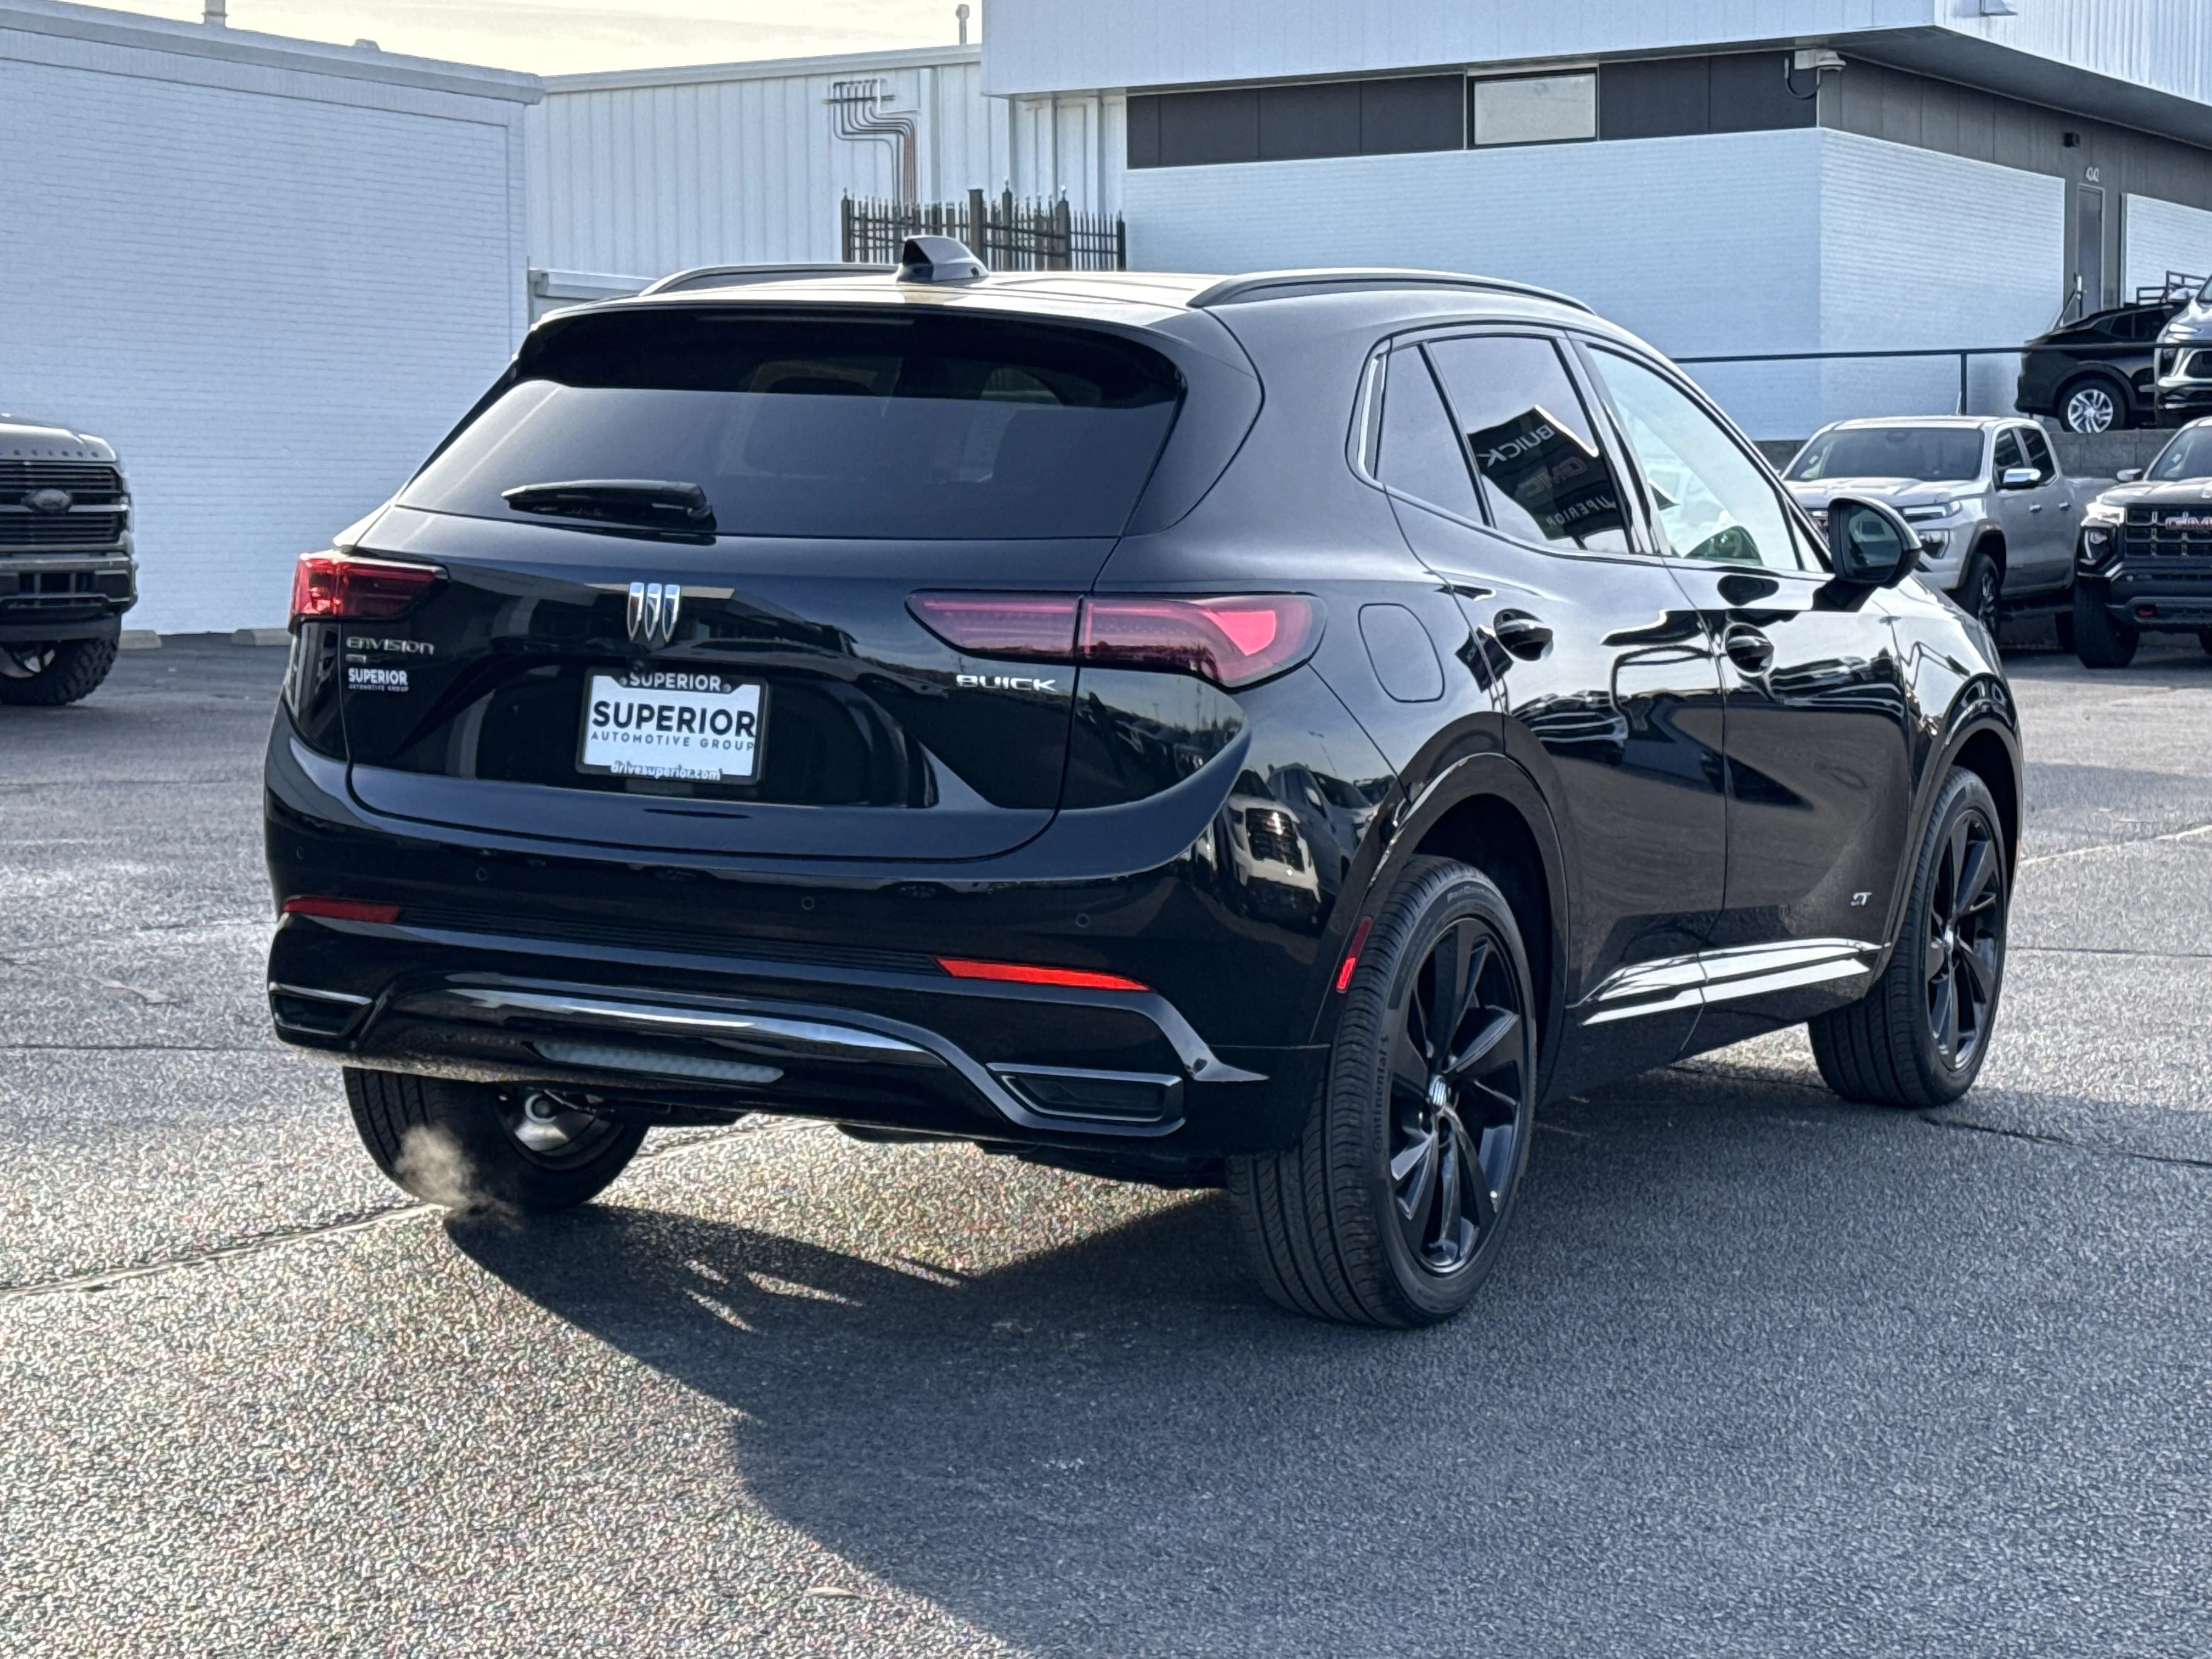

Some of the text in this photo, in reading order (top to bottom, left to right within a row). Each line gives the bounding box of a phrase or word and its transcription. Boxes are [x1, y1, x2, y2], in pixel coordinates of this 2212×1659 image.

[348, 667, 408, 686] SUPERIOR
[629, 672, 721, 691] SUPERIOR
[956, 674, 1058, 692] BUICK
[592, 701, 755, 737] SUPERIOR
[591, 731, 754, 751] AUTOMOTIVE GROUP
[611, 761, 721, 781] drivesuperior.com
